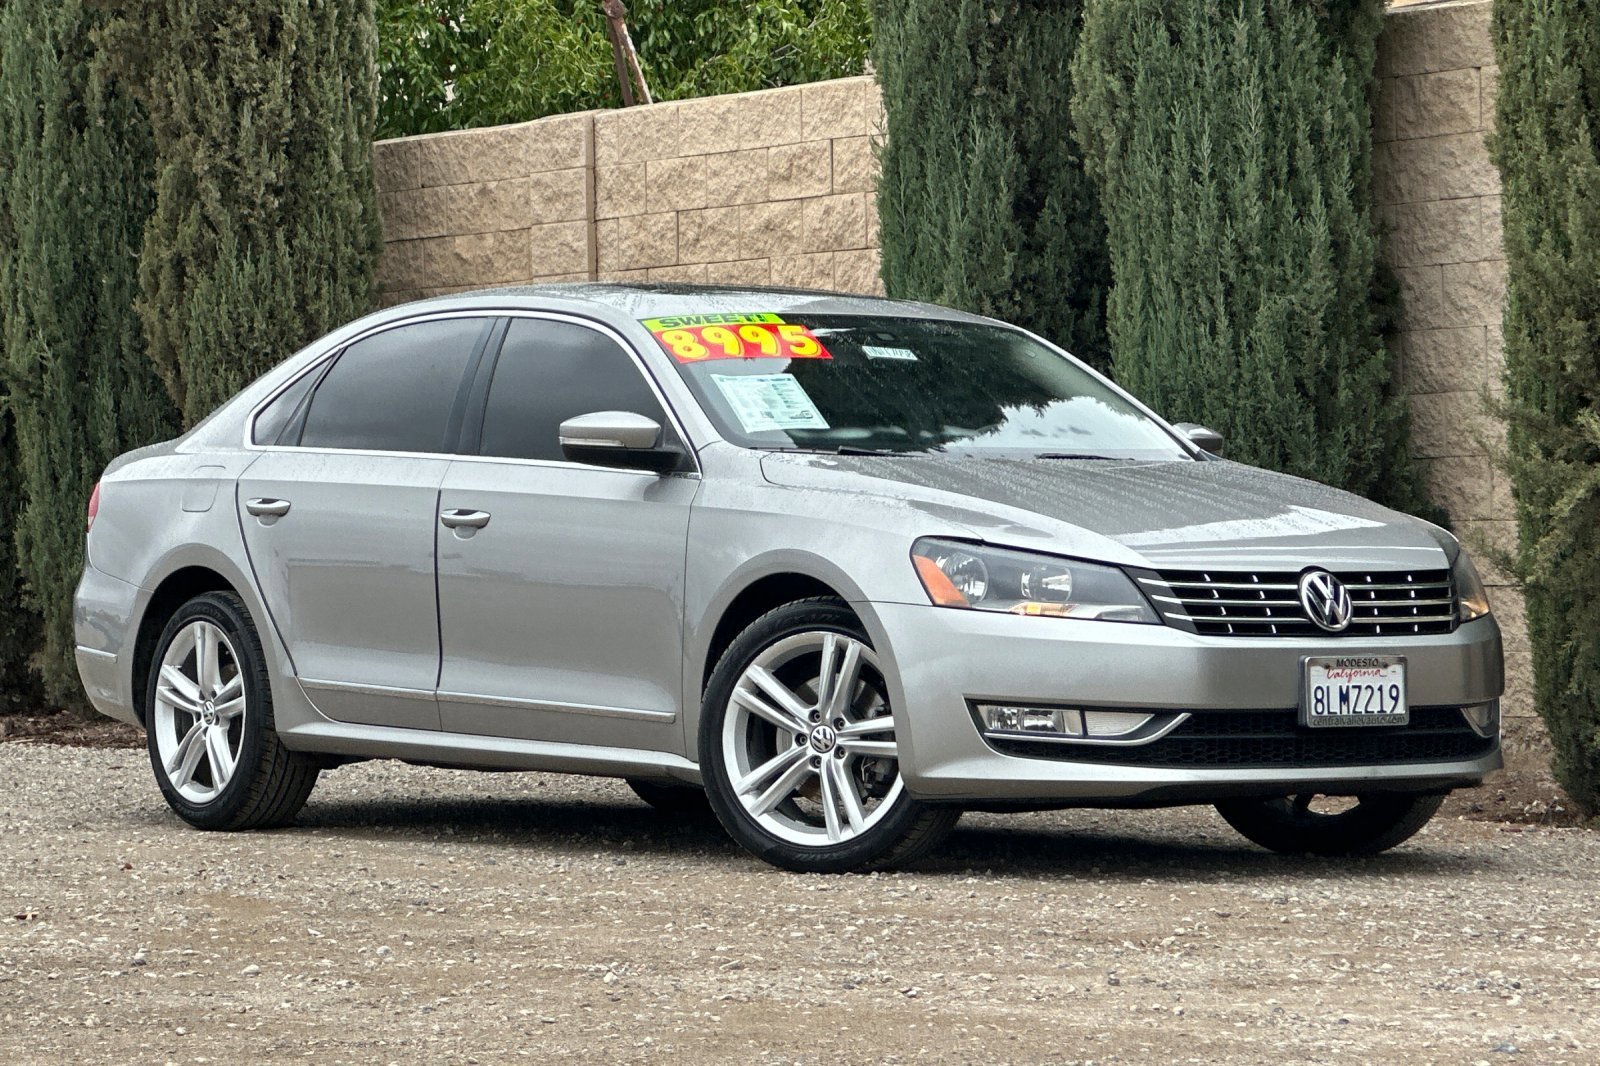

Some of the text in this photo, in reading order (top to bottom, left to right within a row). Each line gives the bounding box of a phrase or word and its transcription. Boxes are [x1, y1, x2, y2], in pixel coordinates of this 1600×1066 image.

[659, 313, 766, 328] SWEET!
[662, 324, 821, 359] 8995
[1299, 571, 1353, 632] VW
[1336, 658, 1379, 668] MODESTO
[1327, 668, 1387, 683] California
[1313, 683, 1400, 715] 8LMZ219
